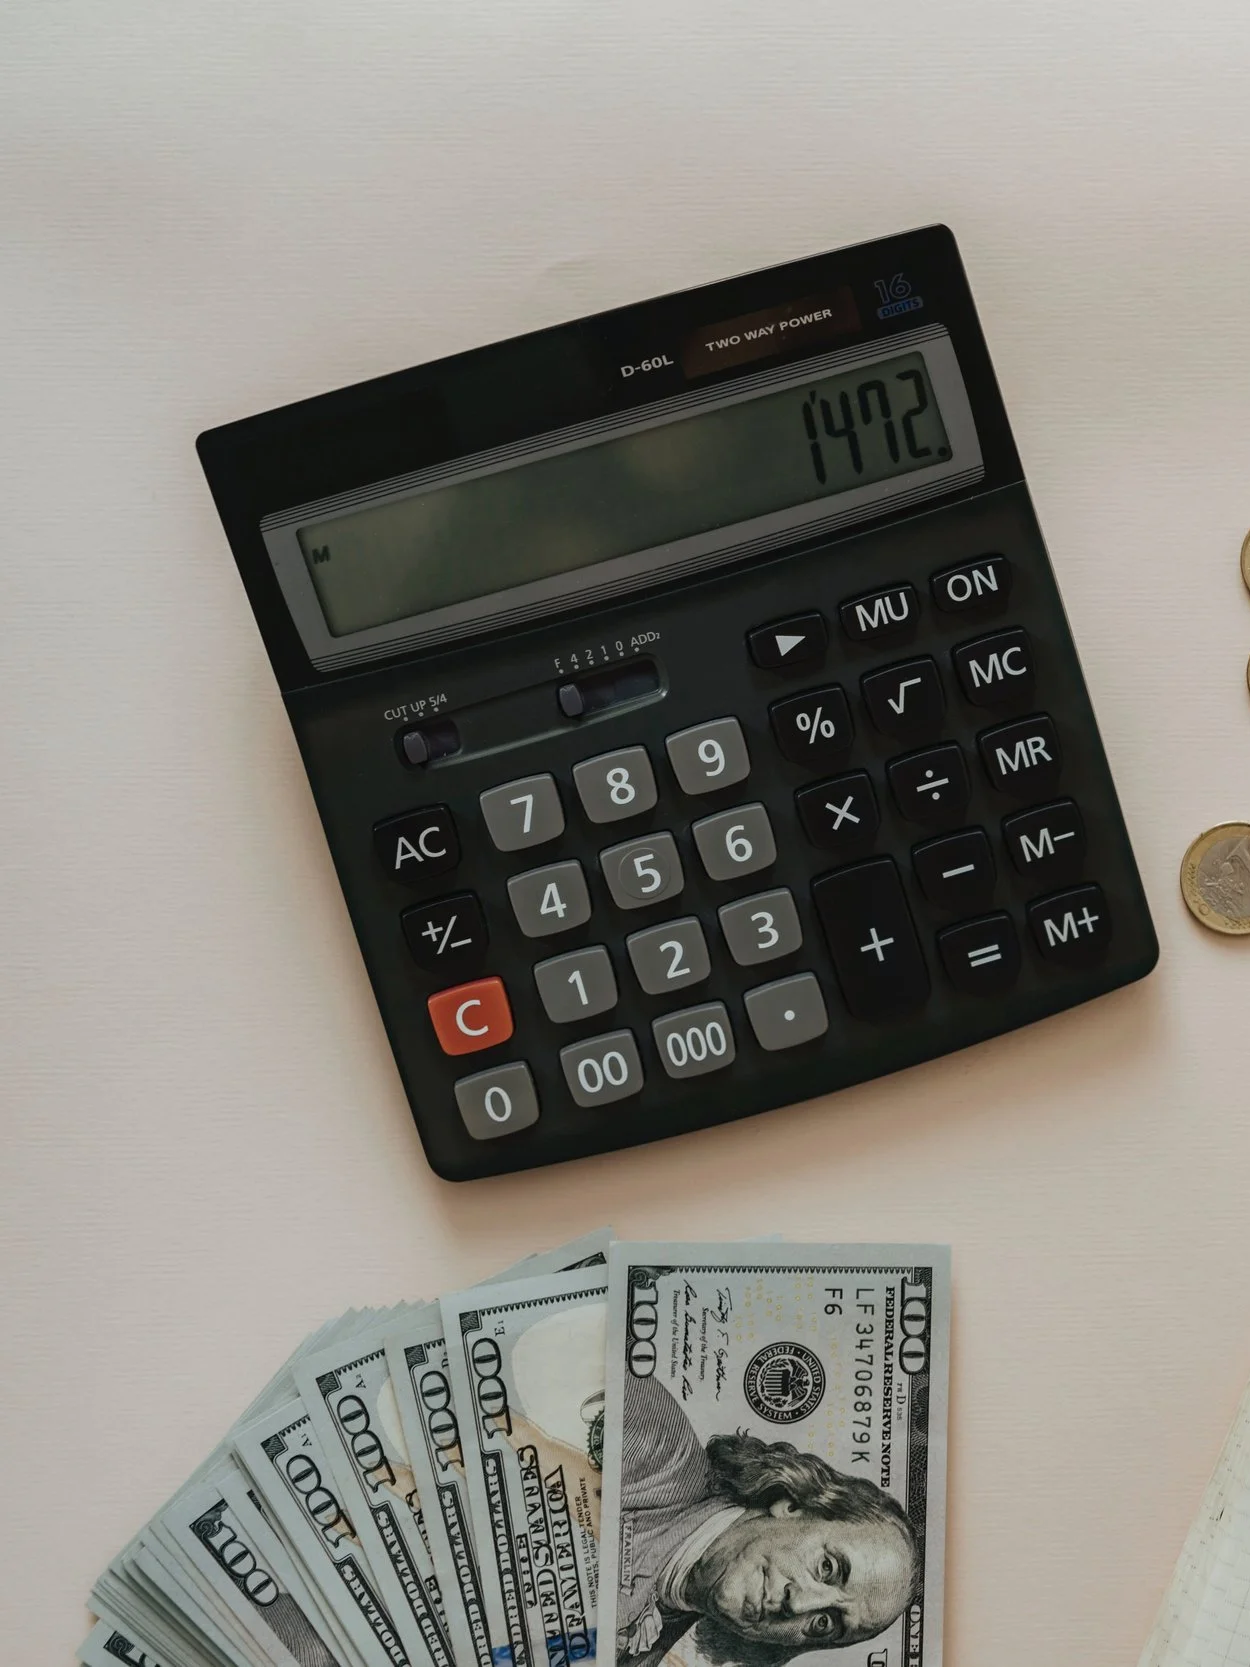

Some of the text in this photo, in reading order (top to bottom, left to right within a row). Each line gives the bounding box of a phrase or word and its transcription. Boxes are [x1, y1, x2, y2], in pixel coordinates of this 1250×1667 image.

[873, 272, 912, 305] 16
[704, 307, 834, 353] TWO WAY POWER
[620, 354, 674, 379] D-60L
[947, 566, 998, 601] ON
[856, 592, 908, 631] MU
[569, 653, 578, 664] 4
[584, 649, 594, 660] 2
[600, 645, 607, 655] 1
[969, 647, 1026, 687] MC
[383, 693, 448, 722] CUT UP 5/4
[796, 707, 835, 744] %
[698, 740, 725, 776] 9
[996, 737, 1052, 775] MR
[607, 768, 635, 804] 8
[510, 794, 533, 833] 7
[396, 827, 446, 869] AC
[726, 825, 752, 861] 6
[634, 854, 661, 892] 5
[540, 883, 566, 917] 4
[751, 912, 778, 948] 3
[1044, 907, 1098, 946] M+
[660, 941, 690, 978] 2
[568, 971, 588, 1005] 1
[456, 1000, 488, 1036] C
[667, 1022, 726, 1066] 000
[578, 1052, 628, 1092] 00
[485, 1087, 511, 1121] 0
[824, 1289, 843, 1315] F6
[625, 1280, 662, 1379] 100
[894, 1276, 930, 1376] 100
[467, 1335, 514, 1440] 100
[748, 1346, 795, 1420] FEDERAL RESERVE SYSTEM
[800, 1352, 821, 1414] UNITED STATES
[852, 1289, 874, 1462] LF 34706879 K
[881, 1287, 895, 1487] FEDERAL RESERVE NOTE
[414, 1368, 468, 1473] 100
[330, 1390, 399, 1495] 100
[279, 1447, 358, 1552] 100
[480, 1457, 514, 1572] DOLLARS
[514, 1443, 556, 1567] STATES
[540, 1464, 586, 1611] AMERICA
[618, 1524, 635, 1583] FRANKLIN
[201, 1517, 285, 1613] 100
